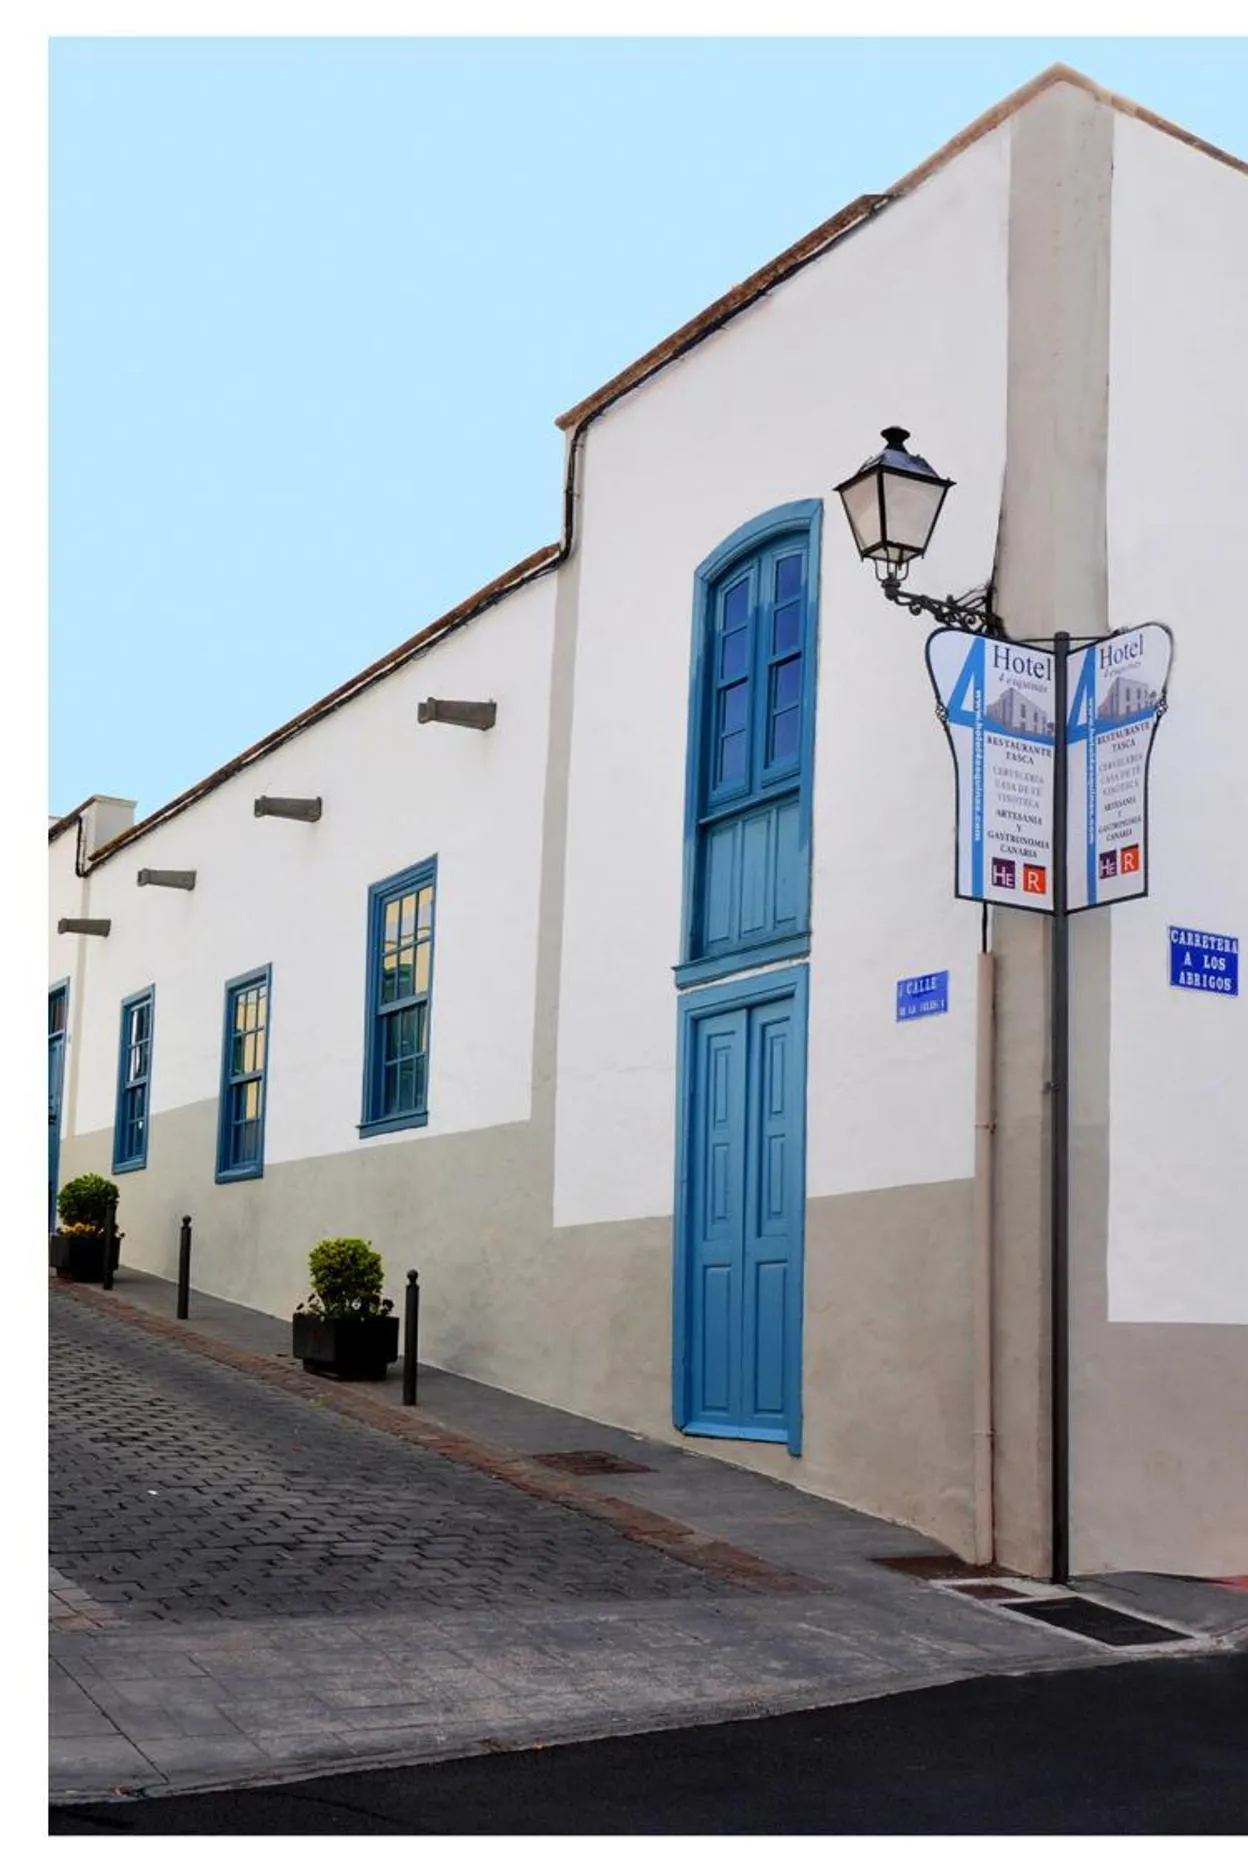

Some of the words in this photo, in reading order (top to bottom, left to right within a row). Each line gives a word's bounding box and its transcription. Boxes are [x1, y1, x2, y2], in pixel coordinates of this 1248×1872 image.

[1100, 633, 1143, 669] Hotel
[993, 645, 1052, 681] Hotel
[1098, 722, 1150, 744] RESTAURANTE
[987, 735, 1052, 758] RESTAURANTE
[1112, 738, 1136, 752] TASCA
[1006, 751, 1034, 765] TASCA
[996, 809, 1043, 825] ARTESANIA
[1016, 823, 1022, 832] Y
[987, 830, 1050, 849] GASTRONOMIA
[1000, 844, 1038, 858] CANARIA
[1124, 853, 1136, 871] R
[992, 864, 1015, 887] HE
[1027, 871, 1042, 892] R
[1171, 930, 1238, 954] CARRETERA
[1184, 951, 1192, 966] A
[1203, 955, 1226, 971] LOS
[906, 976, 937, 995] CALLE
[1179, 971, 1232, 991] ABRIGOS
